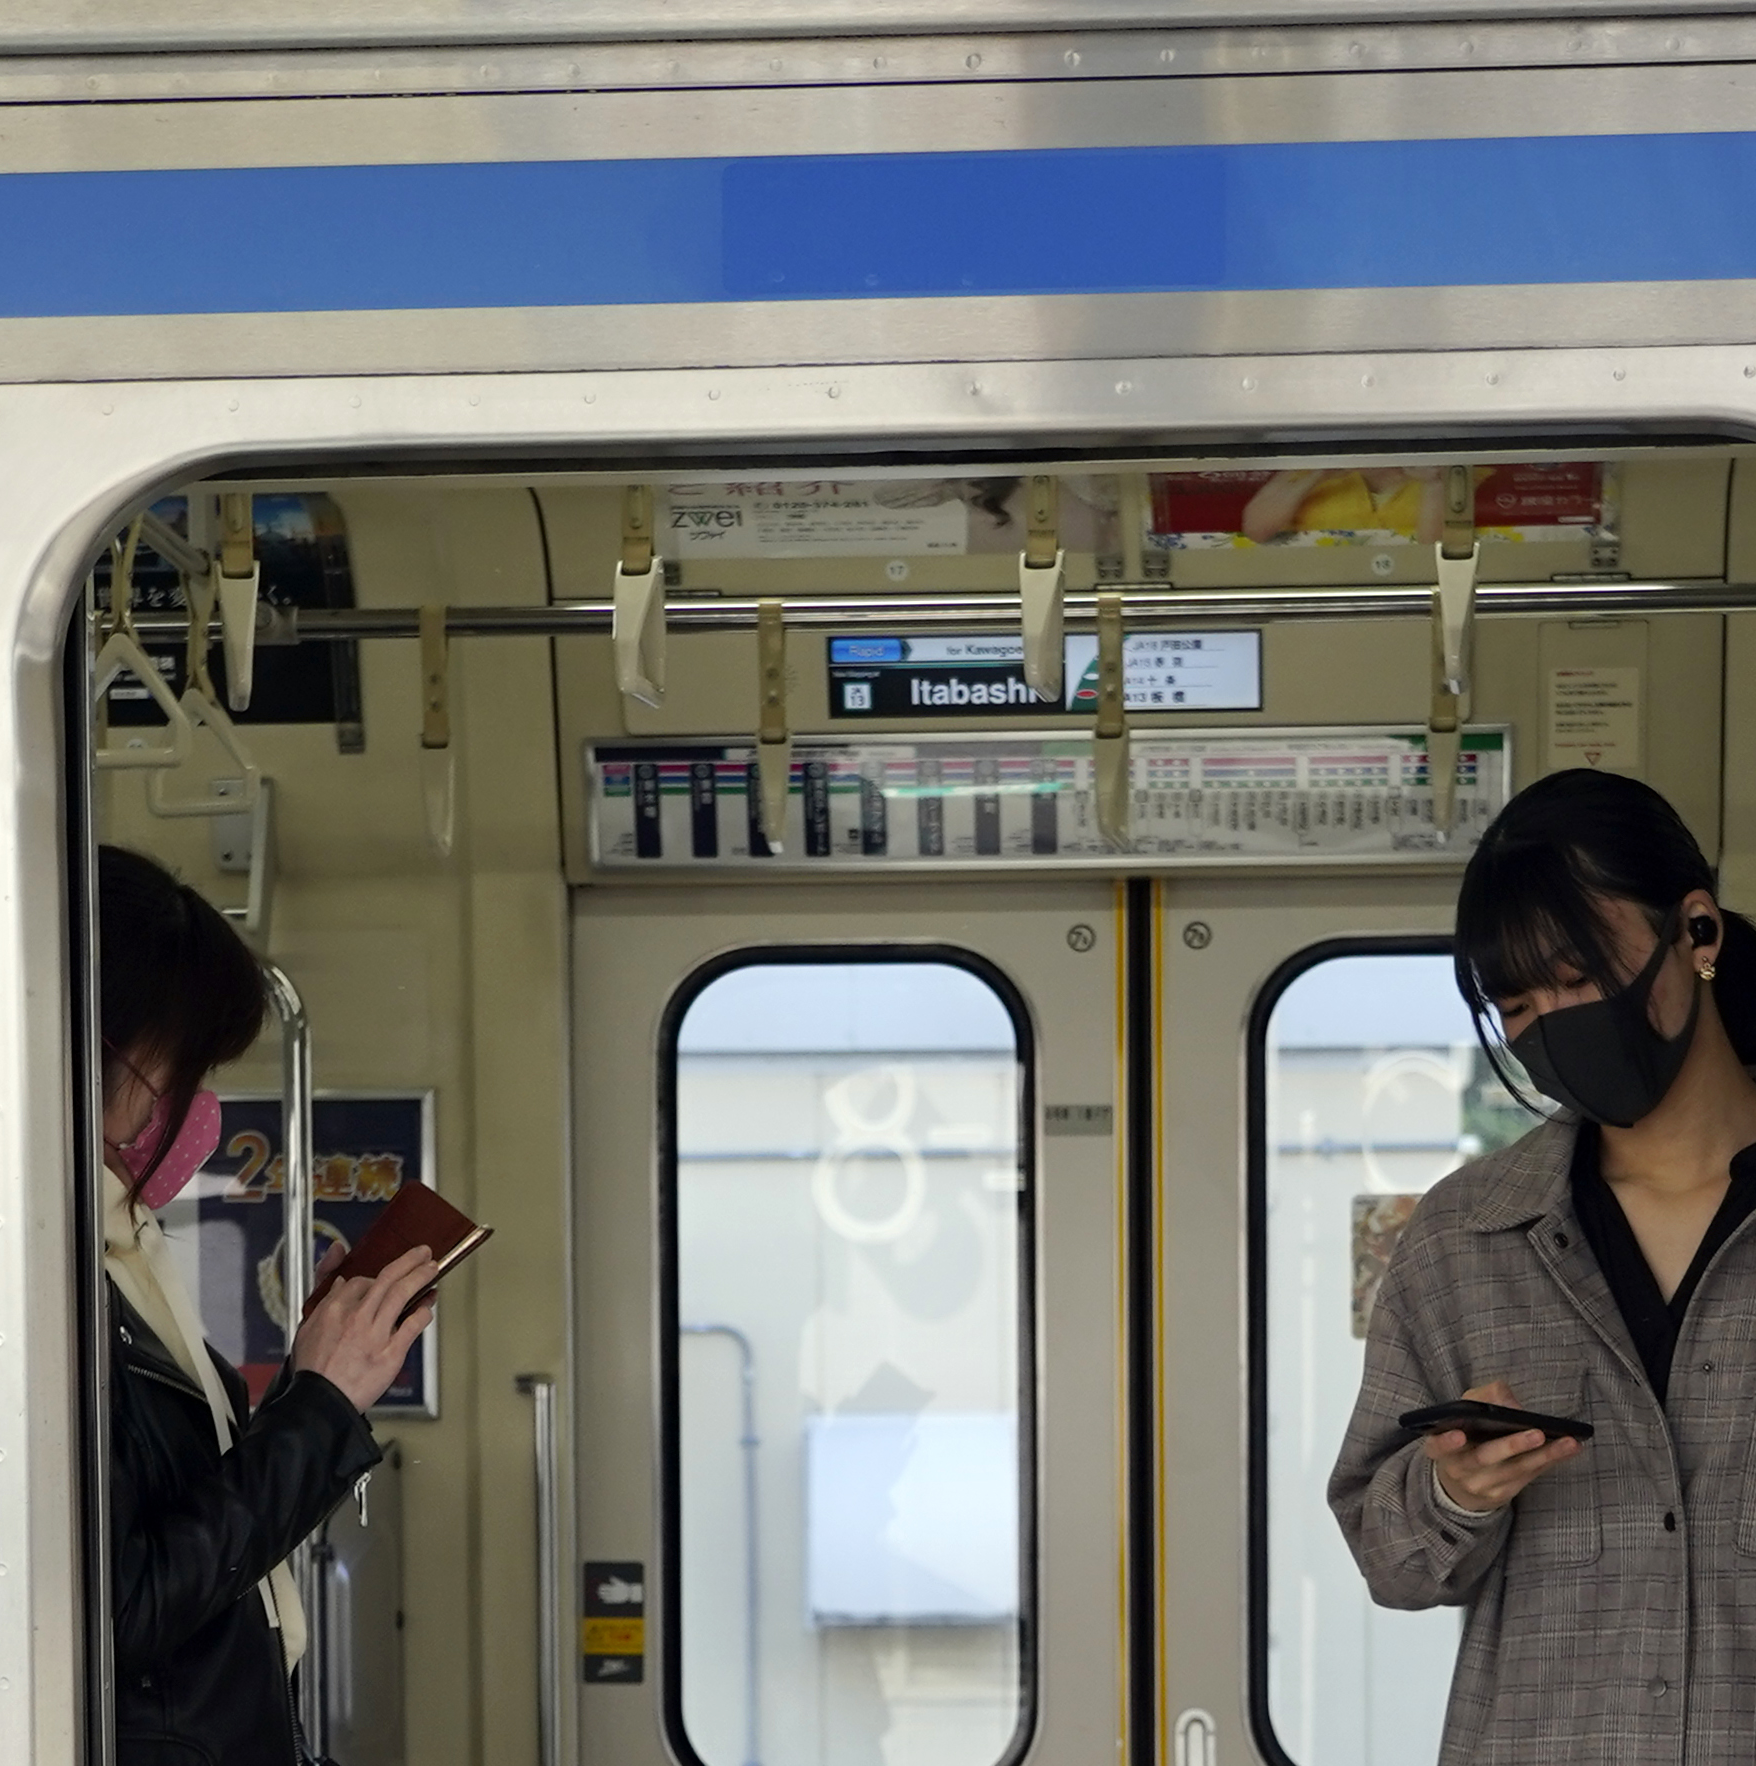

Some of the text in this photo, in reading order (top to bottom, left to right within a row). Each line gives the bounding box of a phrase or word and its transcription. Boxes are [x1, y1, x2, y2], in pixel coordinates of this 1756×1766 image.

[848, 645, 884, 658] Rapid
[946, 645, 962, 656] for
[850, 694, 865, 703] 13
[1123, 692, 1147, 703] A13
